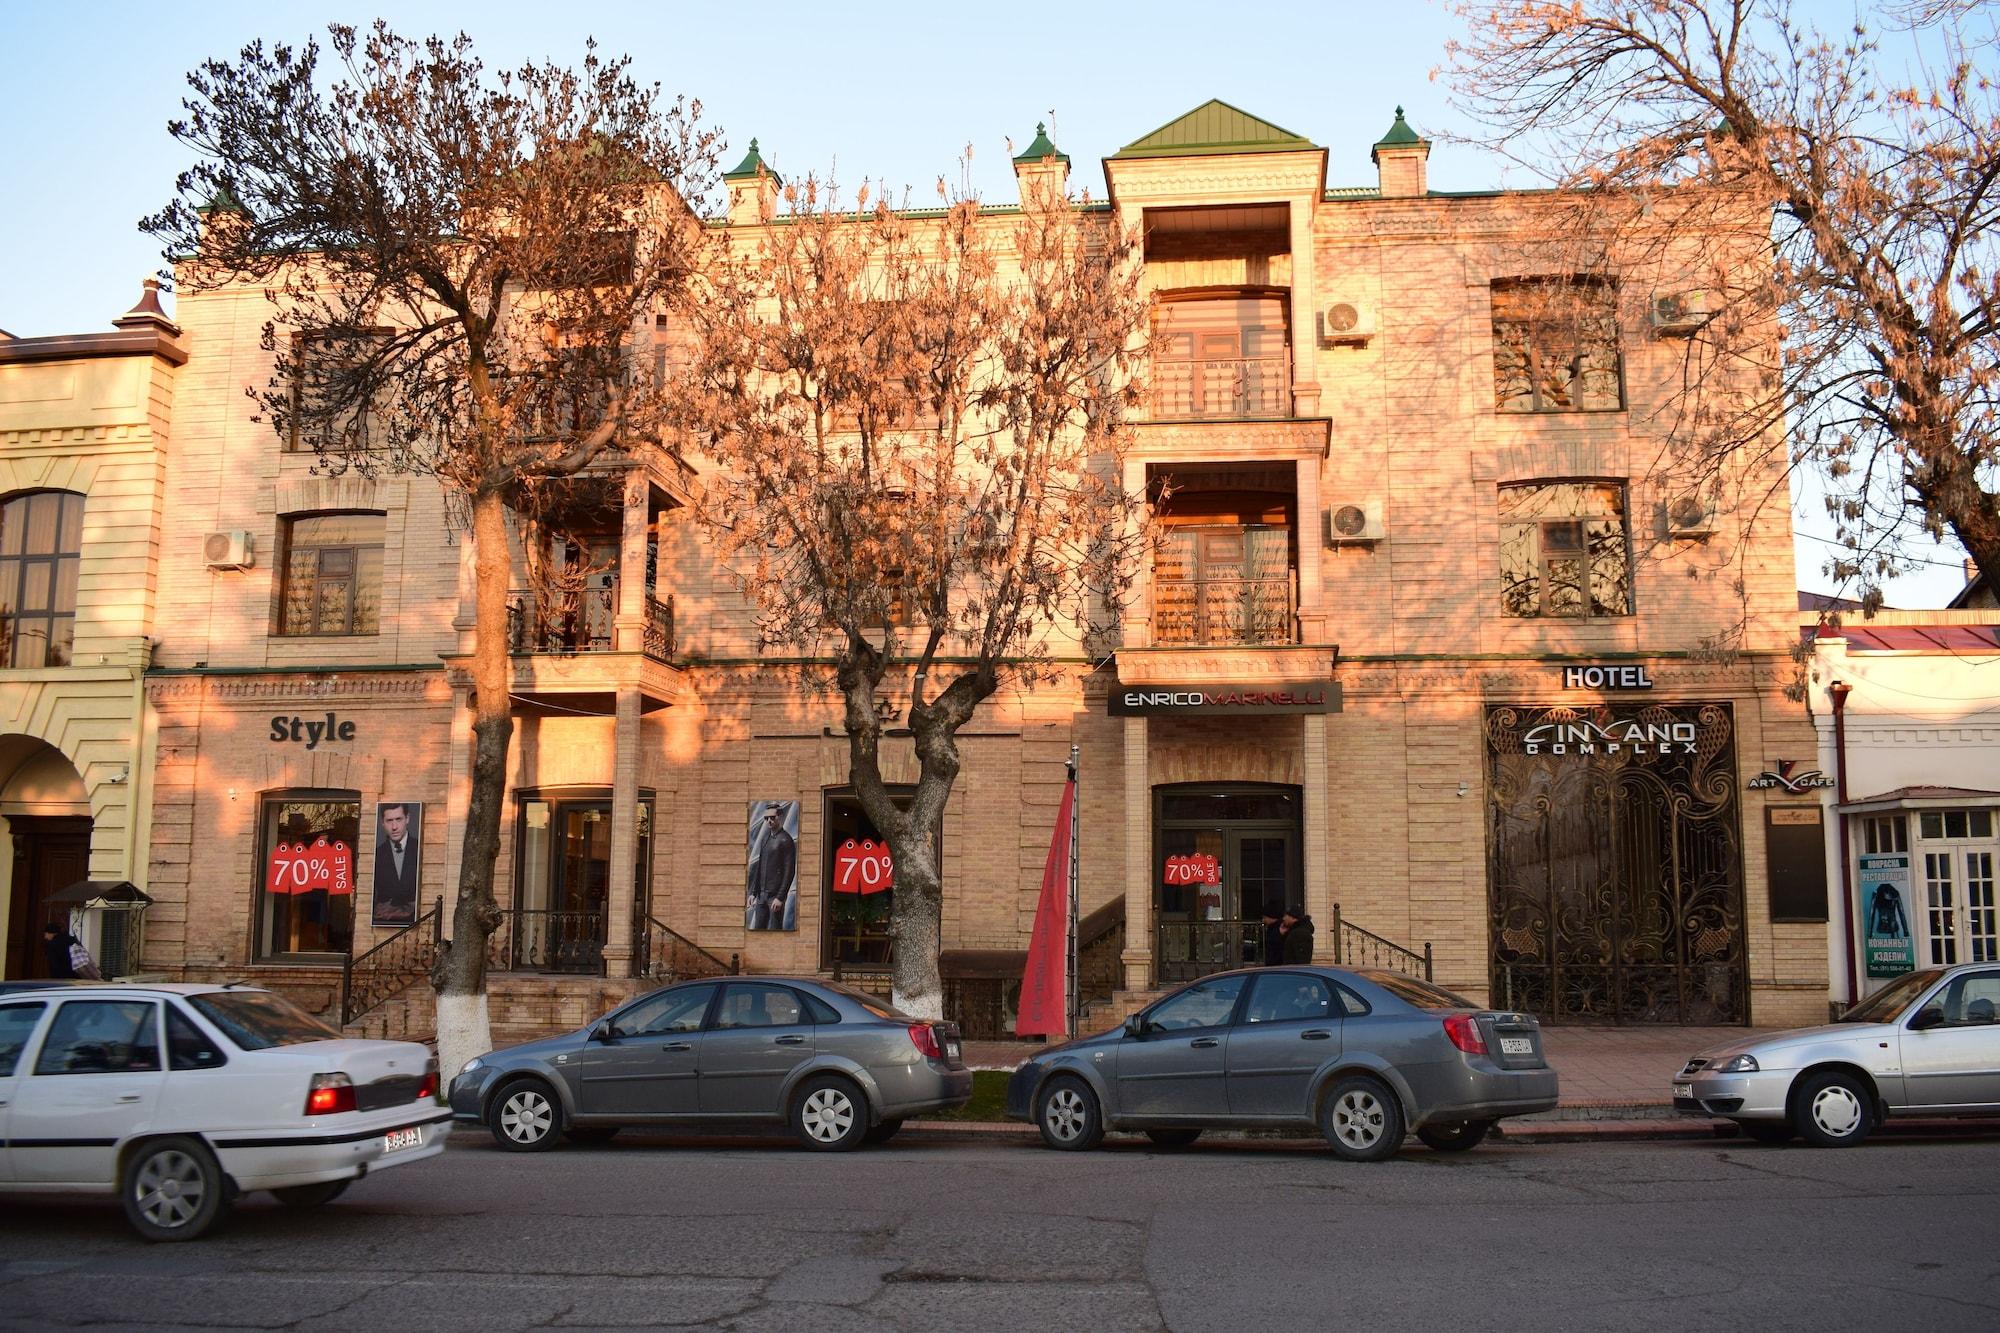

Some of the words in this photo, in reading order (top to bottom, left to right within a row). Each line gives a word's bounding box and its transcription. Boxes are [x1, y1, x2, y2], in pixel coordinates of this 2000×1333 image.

[1566, 667, 1652, 688] HOTEL
[270, 712, 356, 750] Style
[1526, 742, 1698, 755] COMPLEX
[1749, 778, 1777, 788] ART
[1800, 777, 1835, 787] CAFE
[274, 858, 329, 886] 70%
[335, 855, 347, 889] SALE
[1167, 863, 1204, 881] 70%
[1206, 862, 1215, 883] SALE
[1868, 938, 1909, 949] КОЖАННЫХ
[1873, 950, 1907, 962] ИЗДЕЛИЙ
